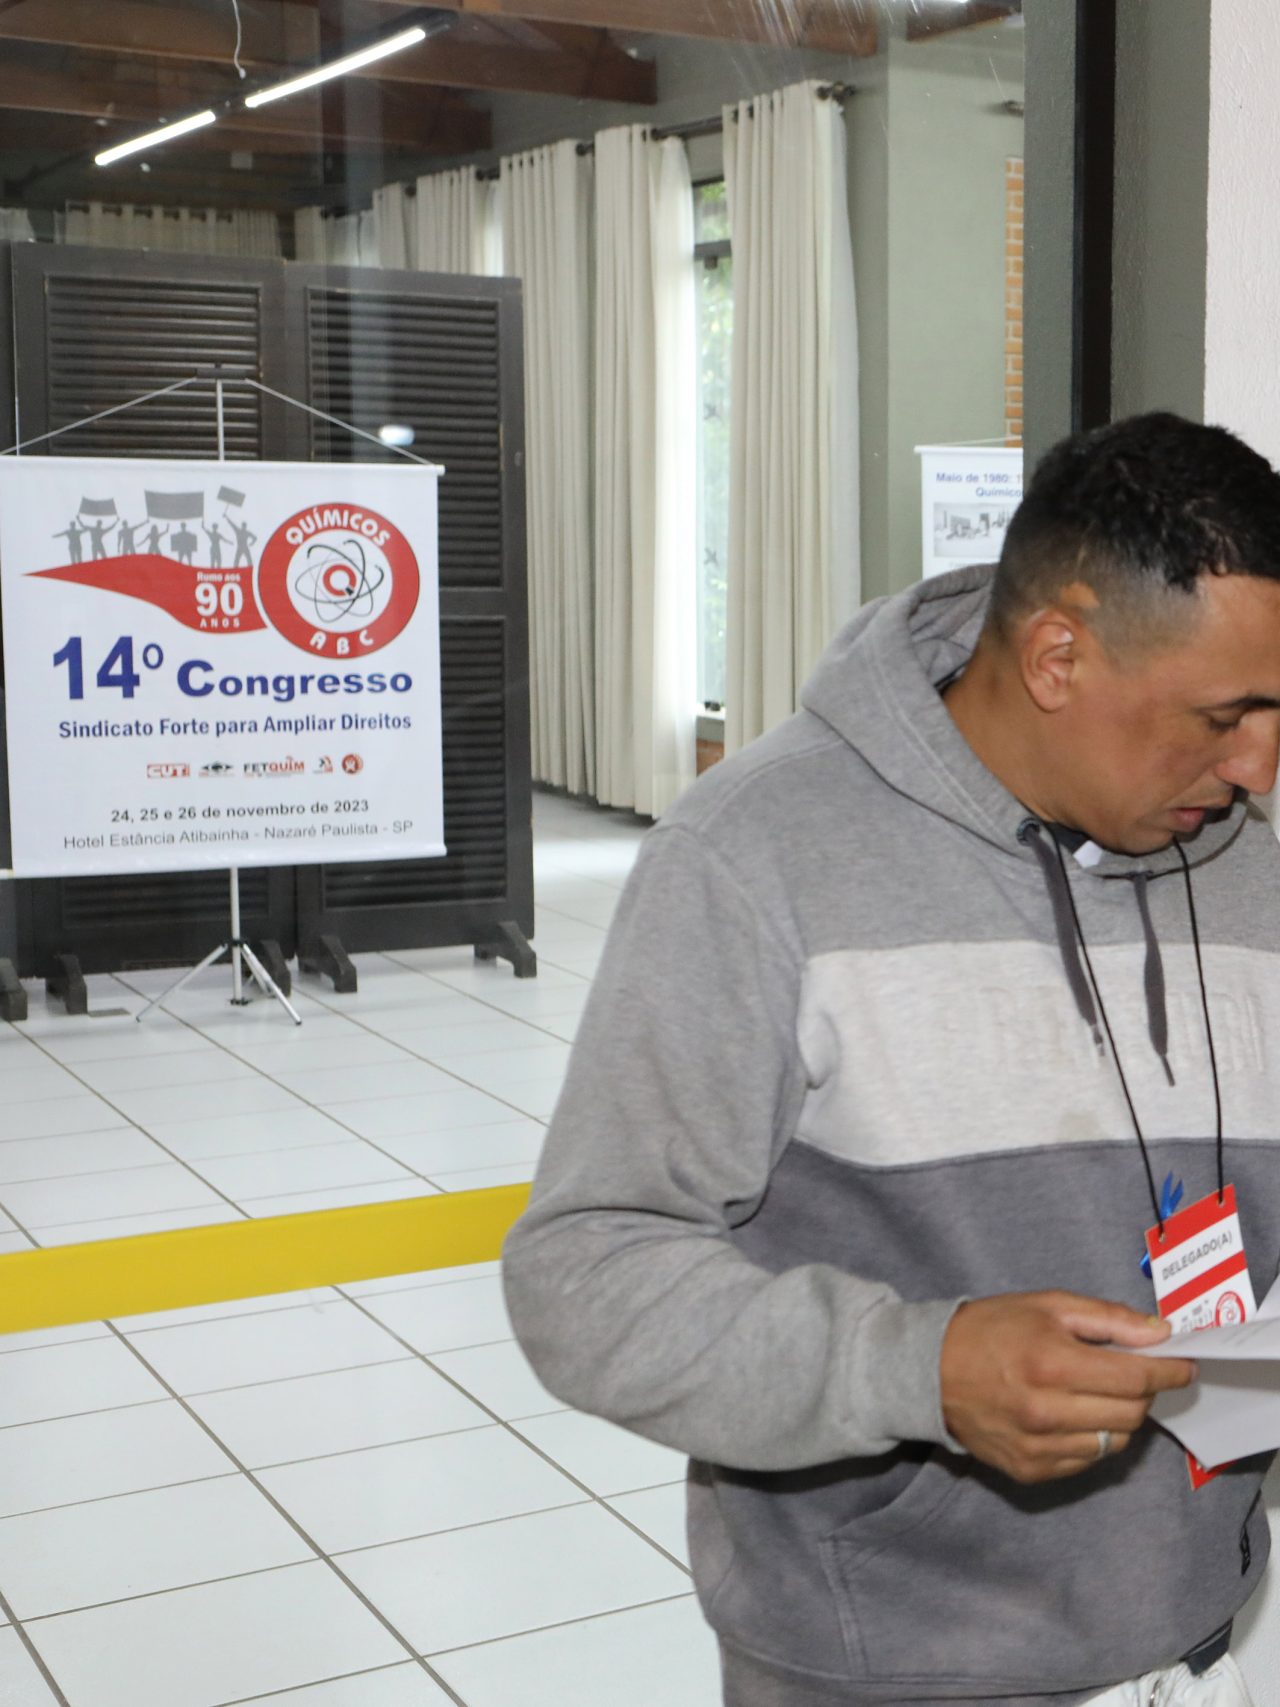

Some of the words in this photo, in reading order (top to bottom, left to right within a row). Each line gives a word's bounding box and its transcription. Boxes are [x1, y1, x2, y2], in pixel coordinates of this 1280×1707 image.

[966, 472, 979, 482] de
[975, 486, 1023, 497] Químico
[286, 507, 391, 546] QUÍMICOS
[197, 571, 223, 582] Rumo
[195, 582, 244, 617] 90
[200, 617, 240, 629] ANOS
[176, 659, 413, 703] Congresso
[59, 719, 154, 739] Sindicato
[159, 717, 210, 736] Forte
[215, 720, 258, 737] para
[263, 714, 336, 735] Ampliar
[341, 712, 412, 731] Direitos
[111, 808, 135, 823] 24,
[140, 807, 158, 821] 25
[163, 809, 173, 820] e
[178, 806, 197, 819] 26
[202, 805, 221, 819] de
[226, 802, 306, 817] novembro
[311, 801, 329, 814] de
[334, 799, 369, 813] 2023
[64, 834, 105, 849] Hotel
[110, 831, 175, 847] Estância
[179, 828, 249, 844] Atibainha
[264, 824, 317, 840] Nazaré
[322, 822, 378, 838] Paulista
[392, 820, 413, 834] SP
[1162, 1230, 1232, 1280] DELEGADO(A)
